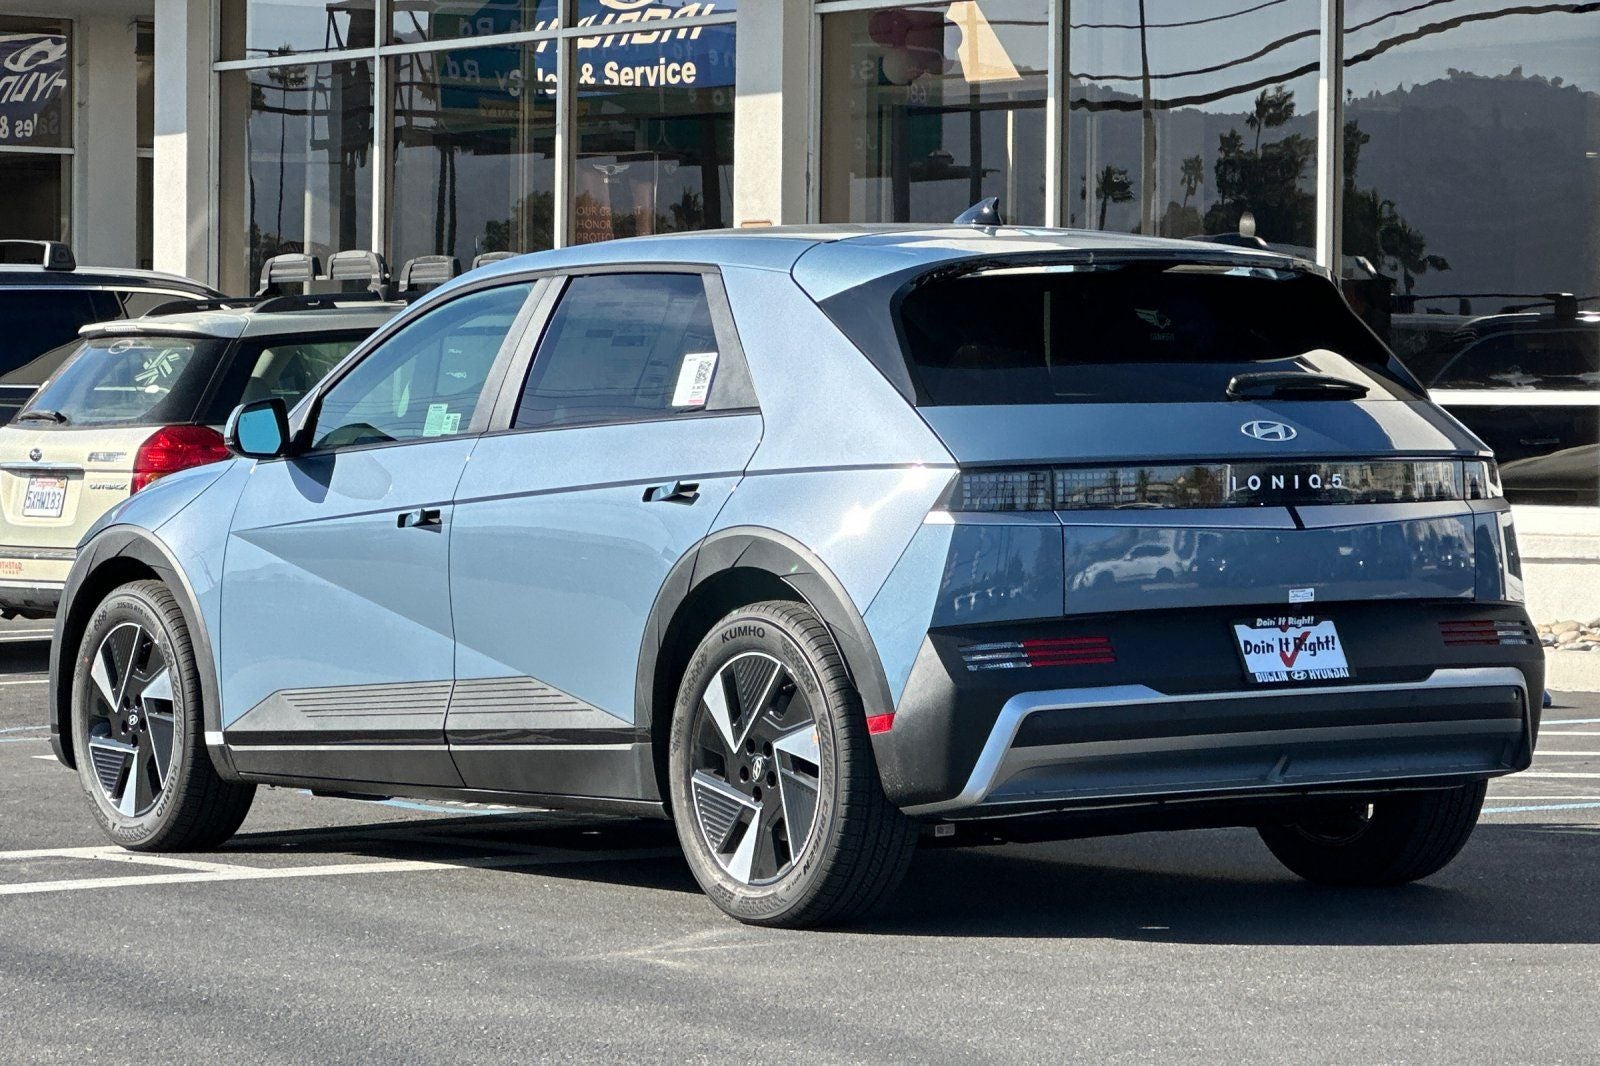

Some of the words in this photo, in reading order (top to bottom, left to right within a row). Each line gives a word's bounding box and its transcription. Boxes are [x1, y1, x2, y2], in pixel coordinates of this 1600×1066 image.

[579, 63, 596, 85] &
[604, 57, 697, 87] Service
[1256, 617, 1276, 627] Doin'
[1288, 615, 1315, 627] Right!
[721, 625, 766, 643] KUMHO
[1243, 637, 1275, 655] Doin'
[1278, 637, 1290, 653] It
[1293, 635, 1336, 656] Right!
[1309, 667, 1350, 680] HYUNDAI
[157, 765, 178, 818] KUMHO
